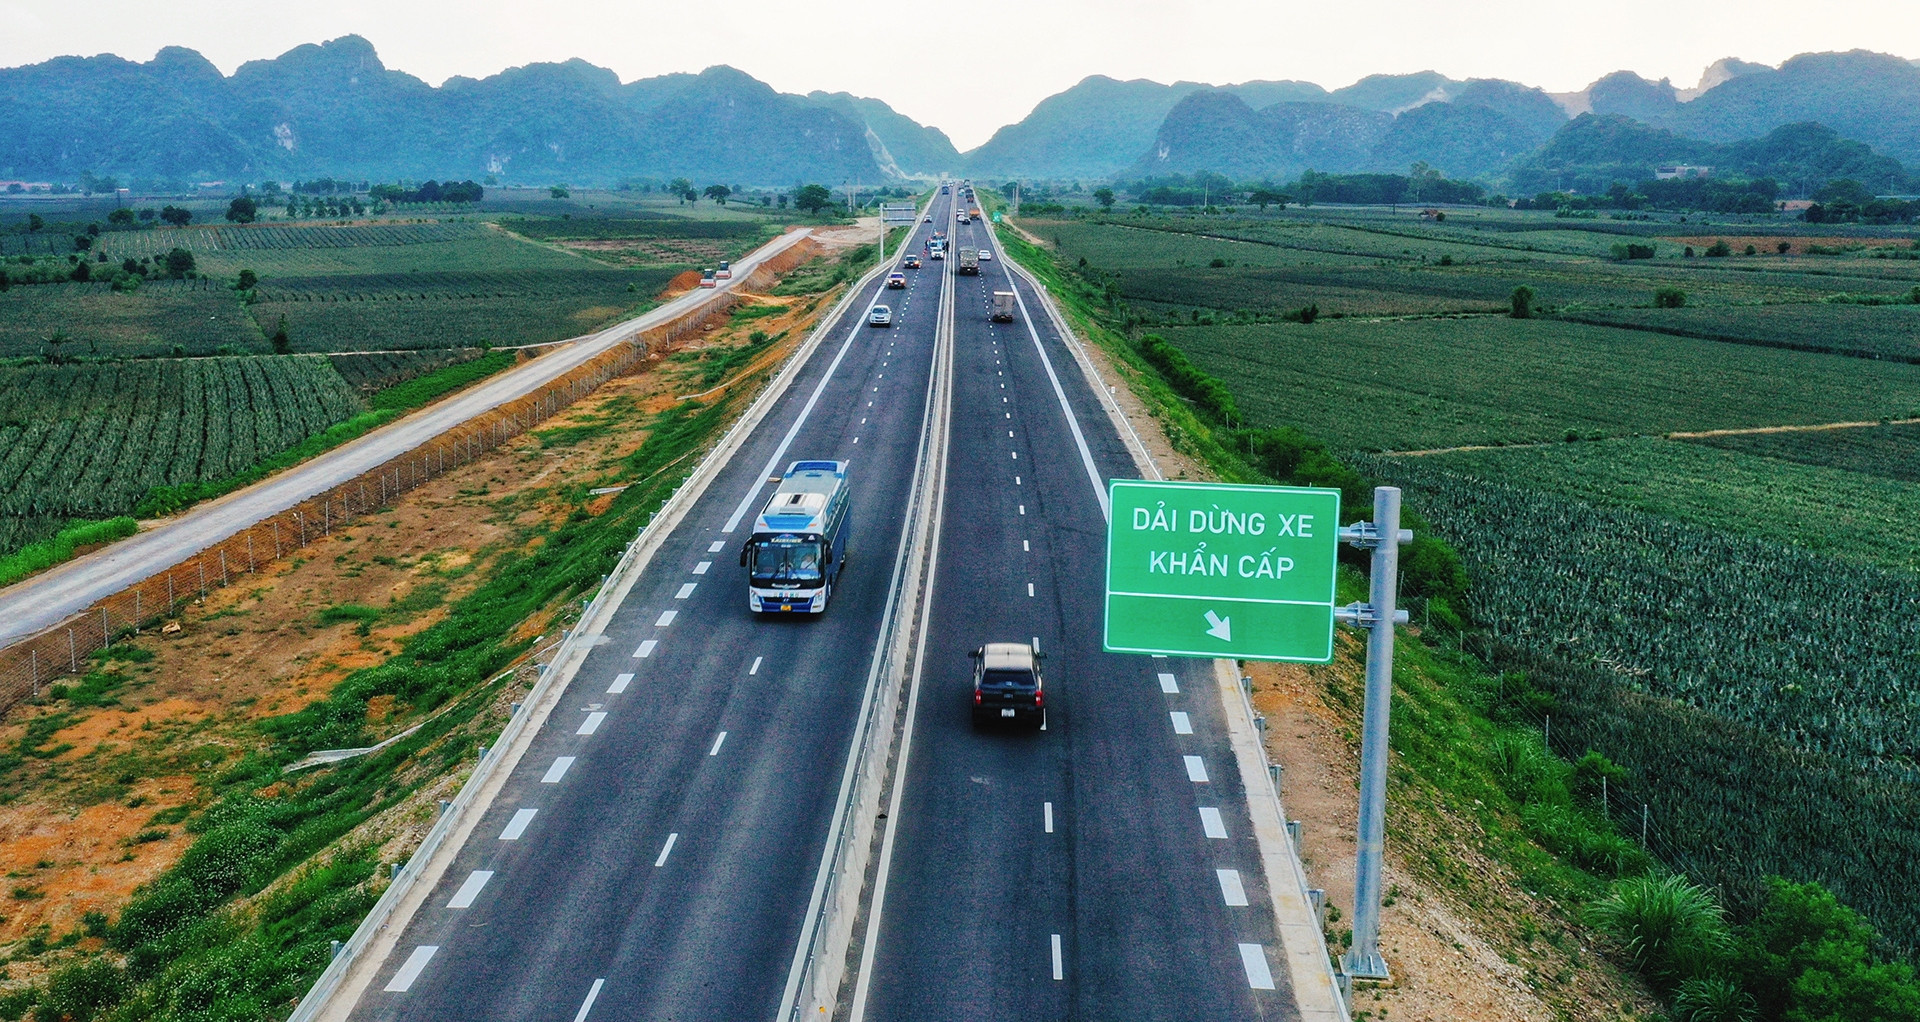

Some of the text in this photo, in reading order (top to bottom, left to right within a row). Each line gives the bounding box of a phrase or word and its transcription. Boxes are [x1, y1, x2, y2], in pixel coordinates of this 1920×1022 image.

[1133, 501, 1314, 538] DẢI DỪNG XE
[1149, 542, 1294, 580] KHẨN CẤP
